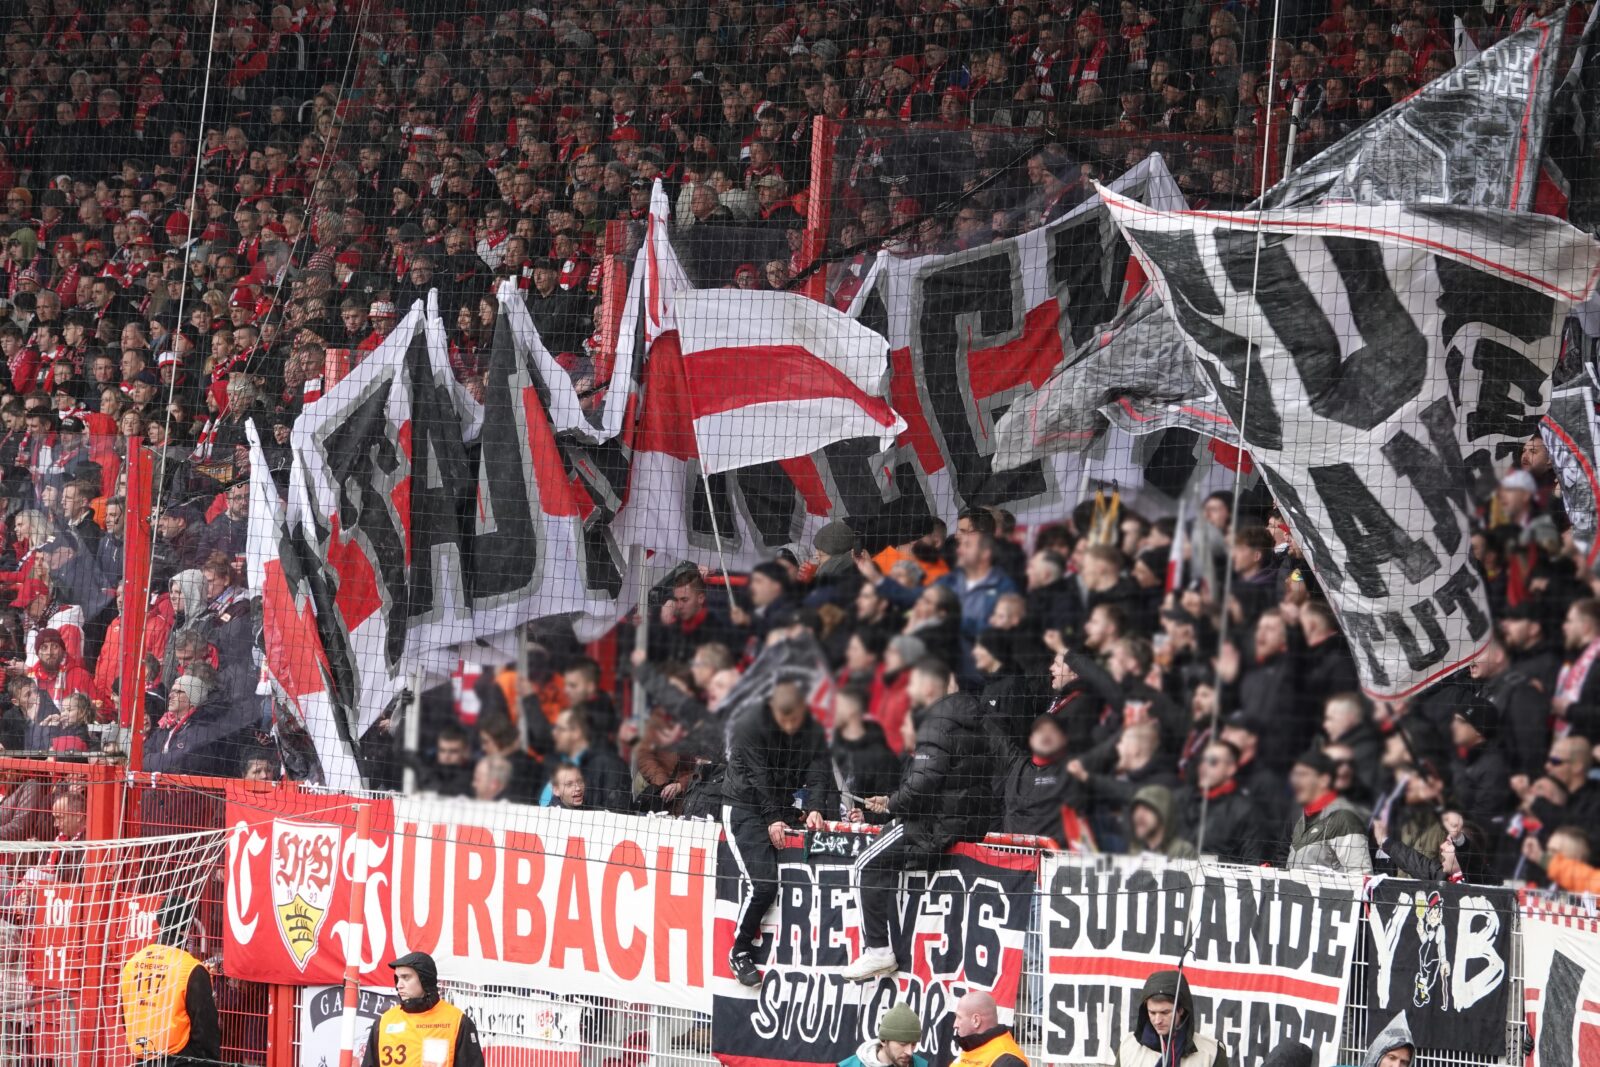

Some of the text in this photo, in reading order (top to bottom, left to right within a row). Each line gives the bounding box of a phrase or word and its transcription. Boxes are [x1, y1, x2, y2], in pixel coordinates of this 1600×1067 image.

[44, 889, 73, 926] Tor
[128, 901, 156, 940] Tor
[401, 821, 707, 989] URBACH
[45, 945, 66, 981] 11
[134, 972, 165, 994] 117
[750, 967, 966, 1057] STUTTGAR
[1046, 983, 1337, 1067] STUTGART
[381, 1044, 407, 1066] 33
